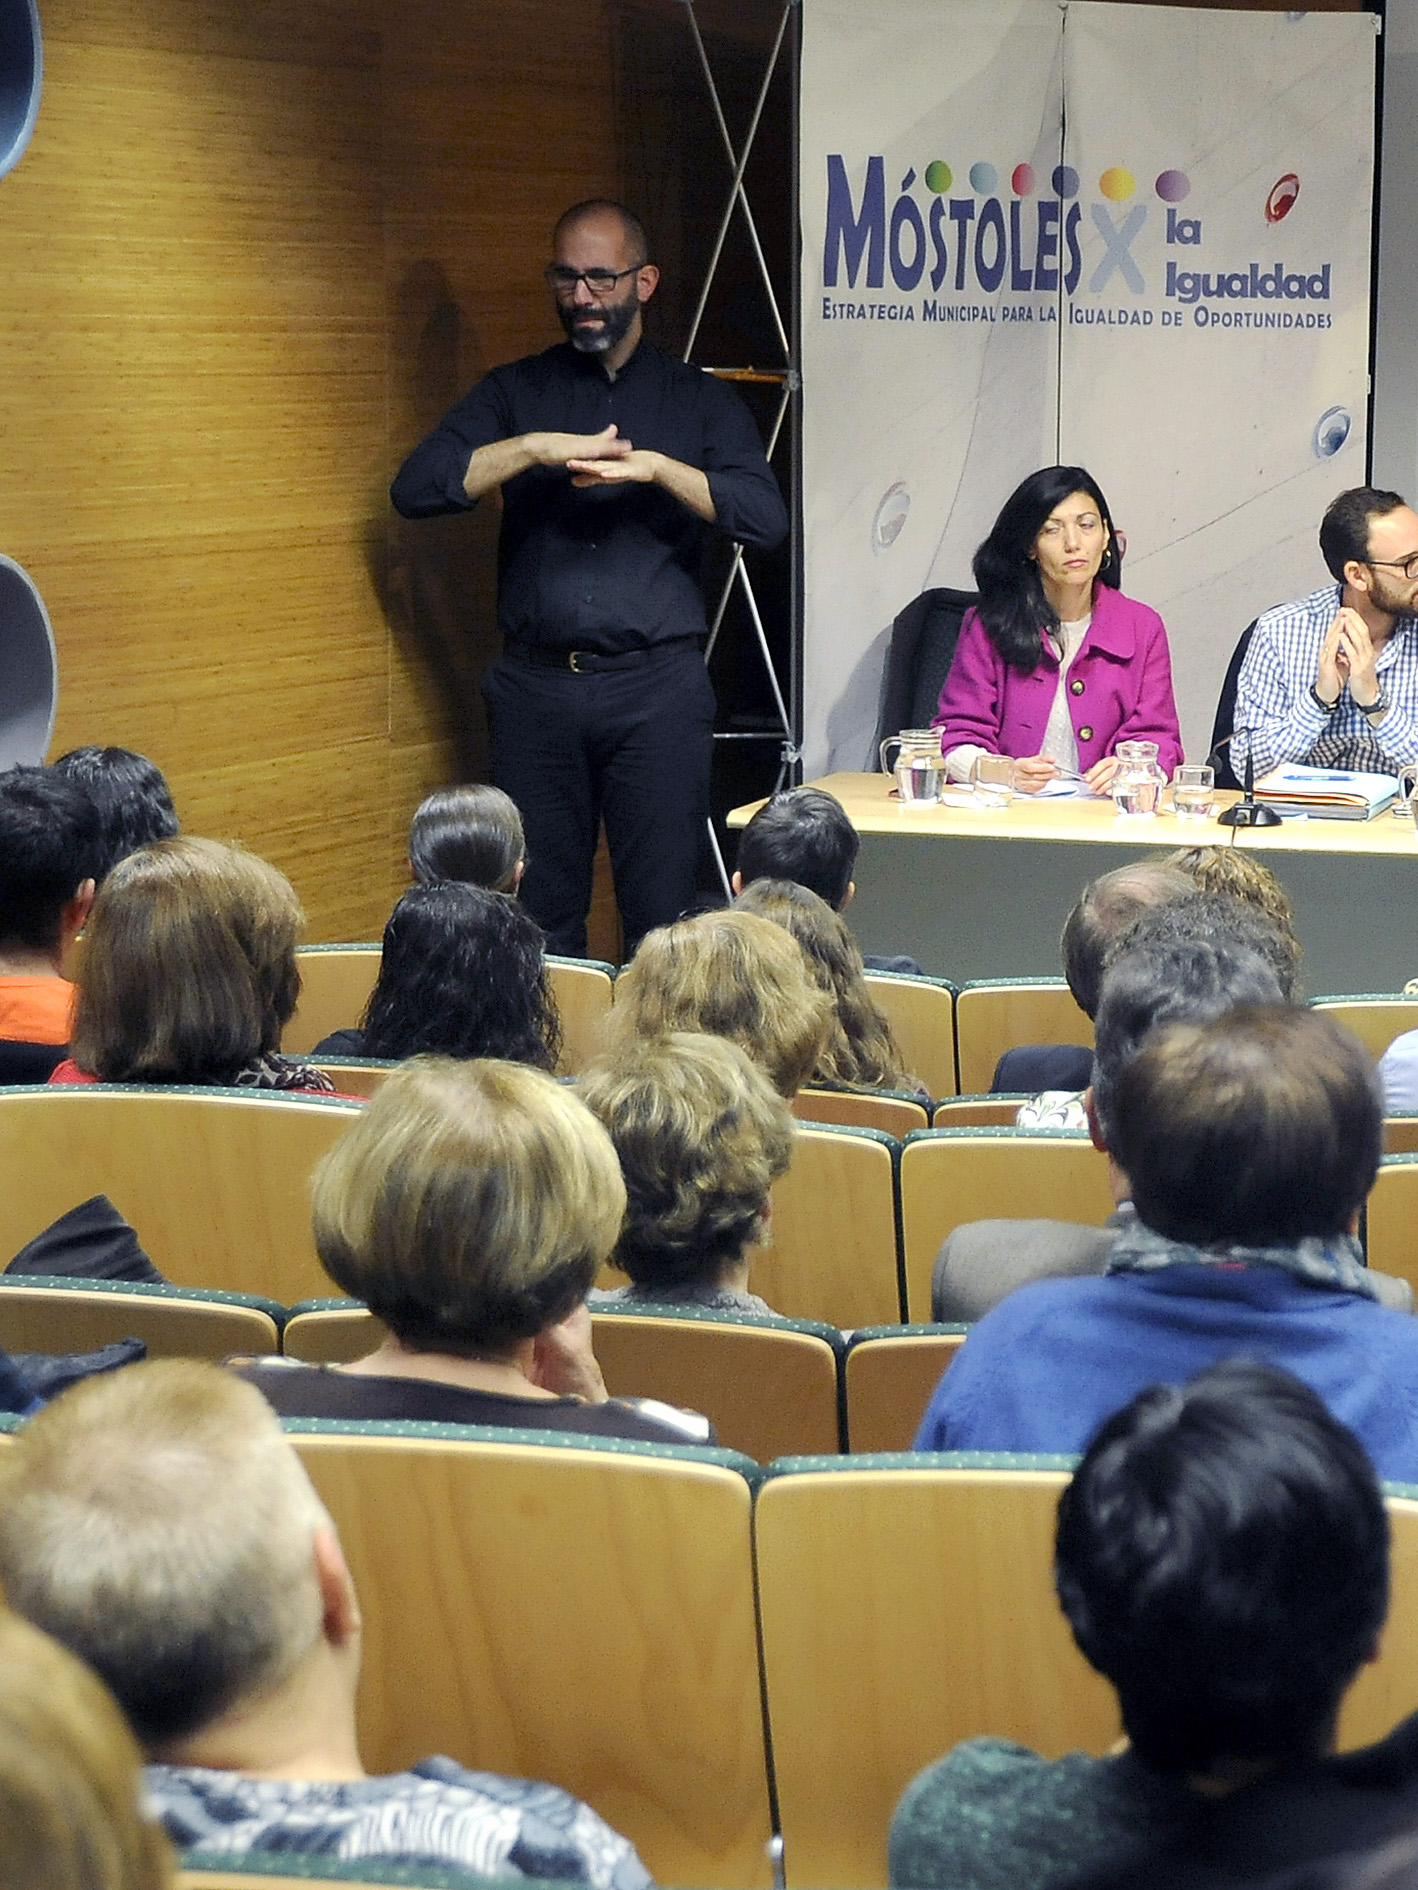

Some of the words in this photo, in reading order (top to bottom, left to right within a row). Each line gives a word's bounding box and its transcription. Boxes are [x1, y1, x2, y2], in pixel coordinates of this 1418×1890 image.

[1165, 208, 1202, 246] la
[1165, 261, 1332, 304] Igualdad
[1001, 304, 1035, 323] PARA
[1038, 305, 1058, 323] LA
[1161, 310, 1184, 327] DE
